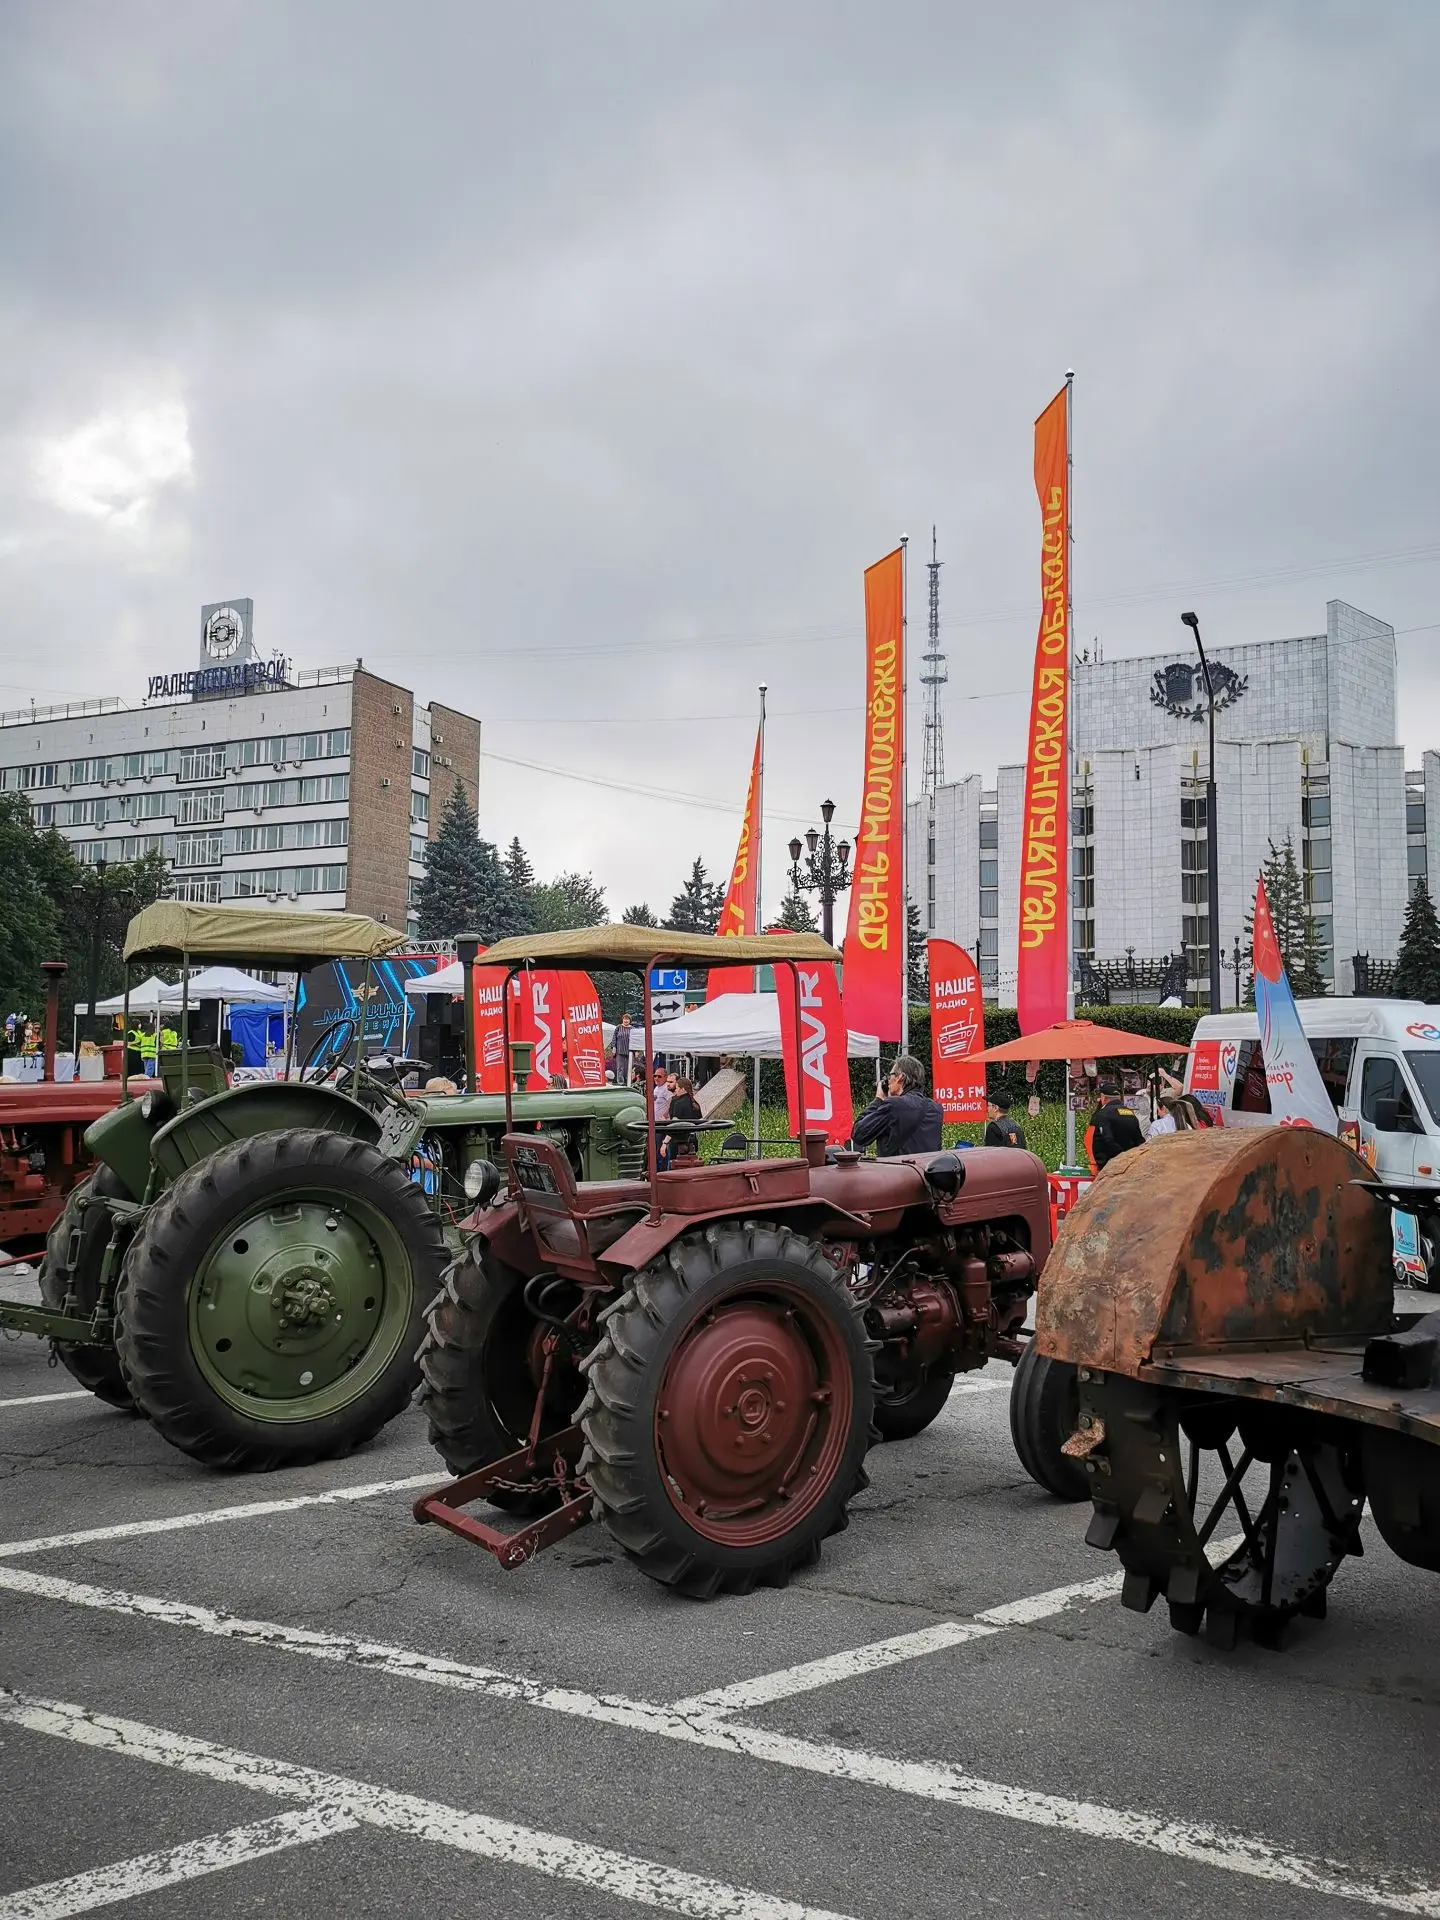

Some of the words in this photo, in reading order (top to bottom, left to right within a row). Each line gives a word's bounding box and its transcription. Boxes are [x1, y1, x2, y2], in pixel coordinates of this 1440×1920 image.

[479, 985, 503, 1004] НАШ
[935, 976, 976, 998] НАШЕ
[936, 998, 967, 1010] РАДИО
[799, 971, 832, 1121] LAVR
[935, 1087, 964, 1101] 103,5
[968, 1086, 985, 1099] FM
[942, 1102, 982, 1112] ЕЛЯБИНСК
